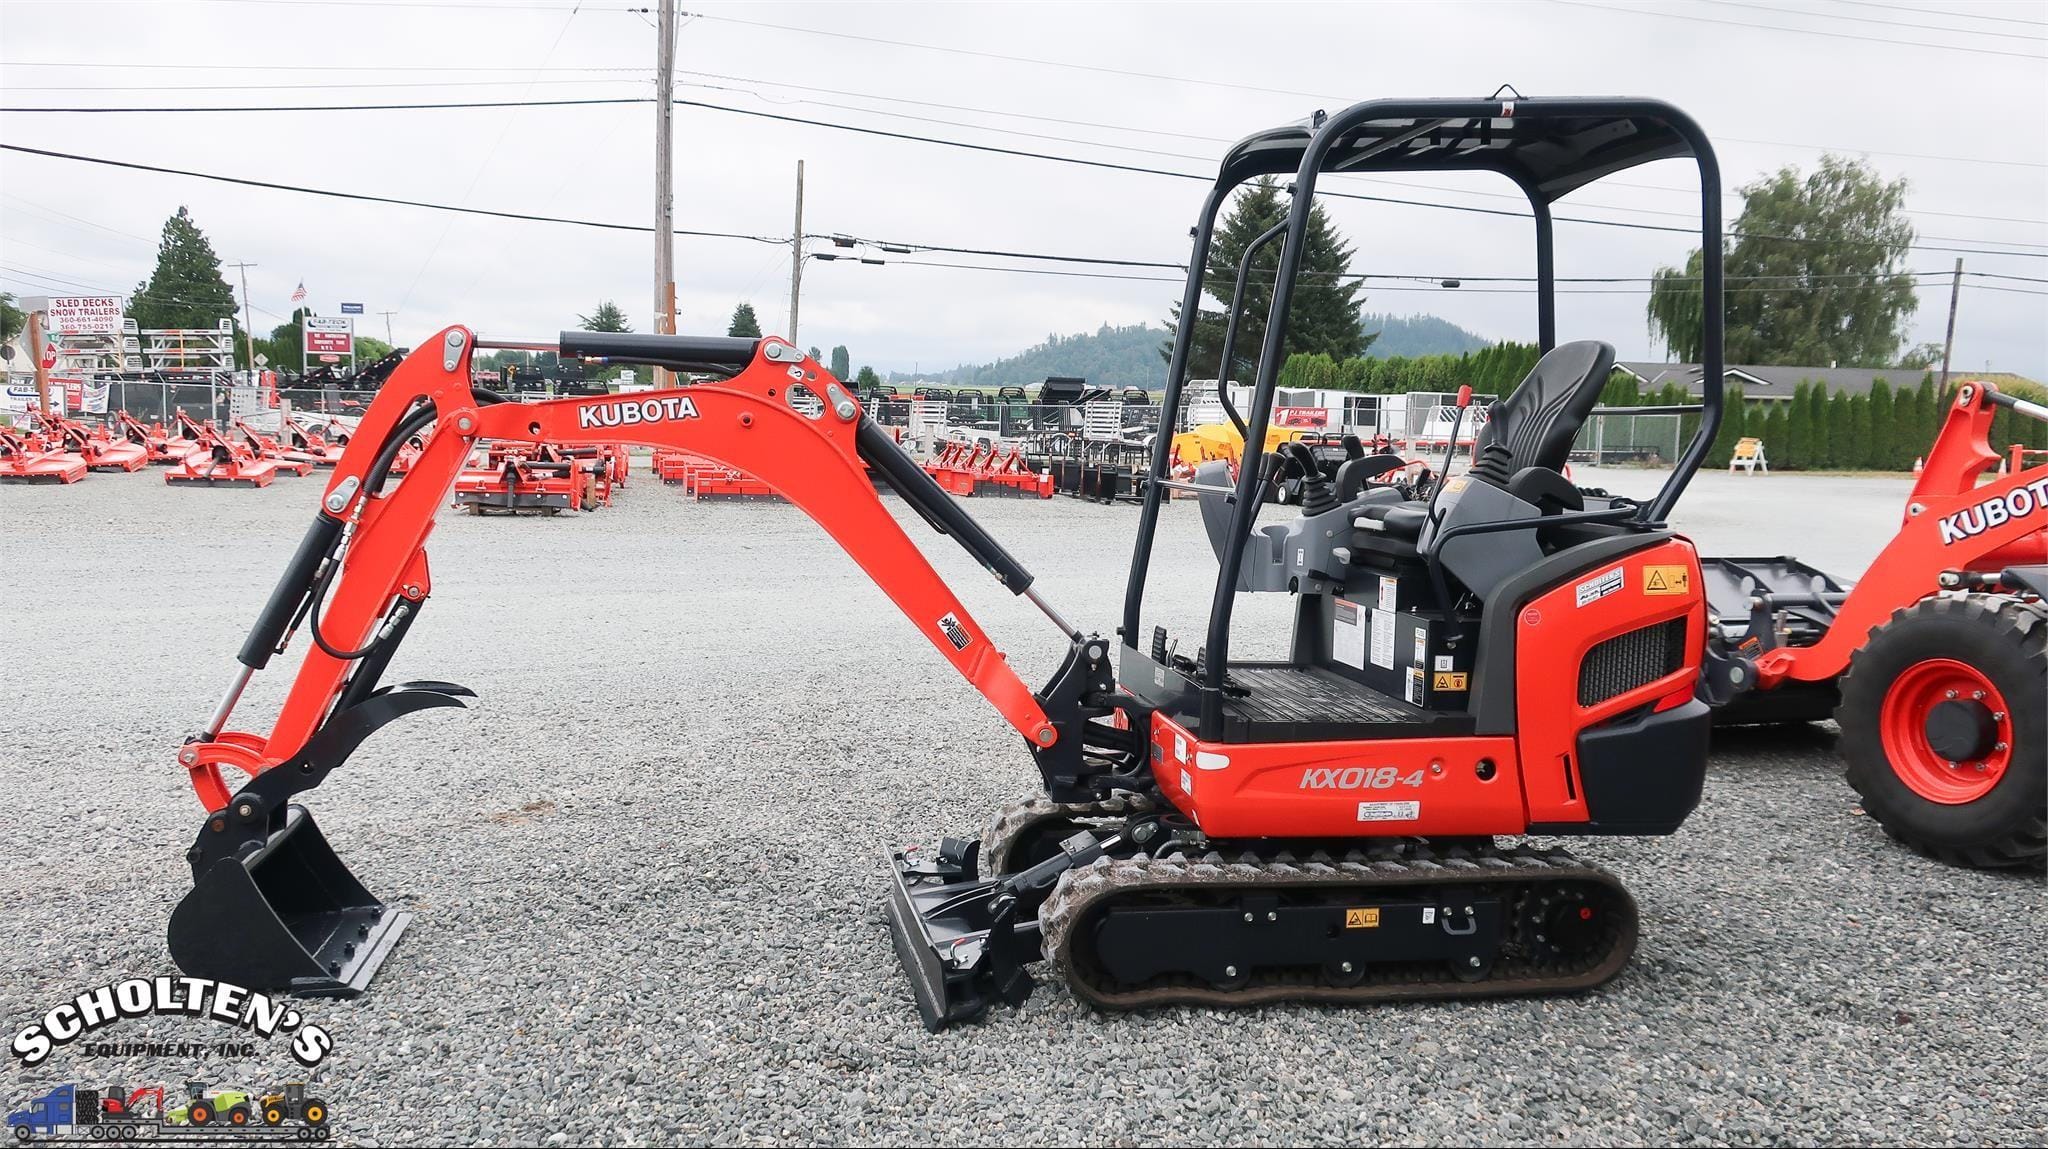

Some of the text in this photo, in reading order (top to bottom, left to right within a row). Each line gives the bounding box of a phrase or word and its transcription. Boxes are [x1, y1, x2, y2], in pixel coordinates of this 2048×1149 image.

[56, 298, 114, 307] SLED DECKS
[50, 307, 120, 316] SNOW TRAILERS
[43, 350, 56, 361] TOP
[579, 396, 699, 428] KUBOTA
[1938, 477, 2048, 546] KUBOT
[1299, 767, 1425, 790] KX018-4
